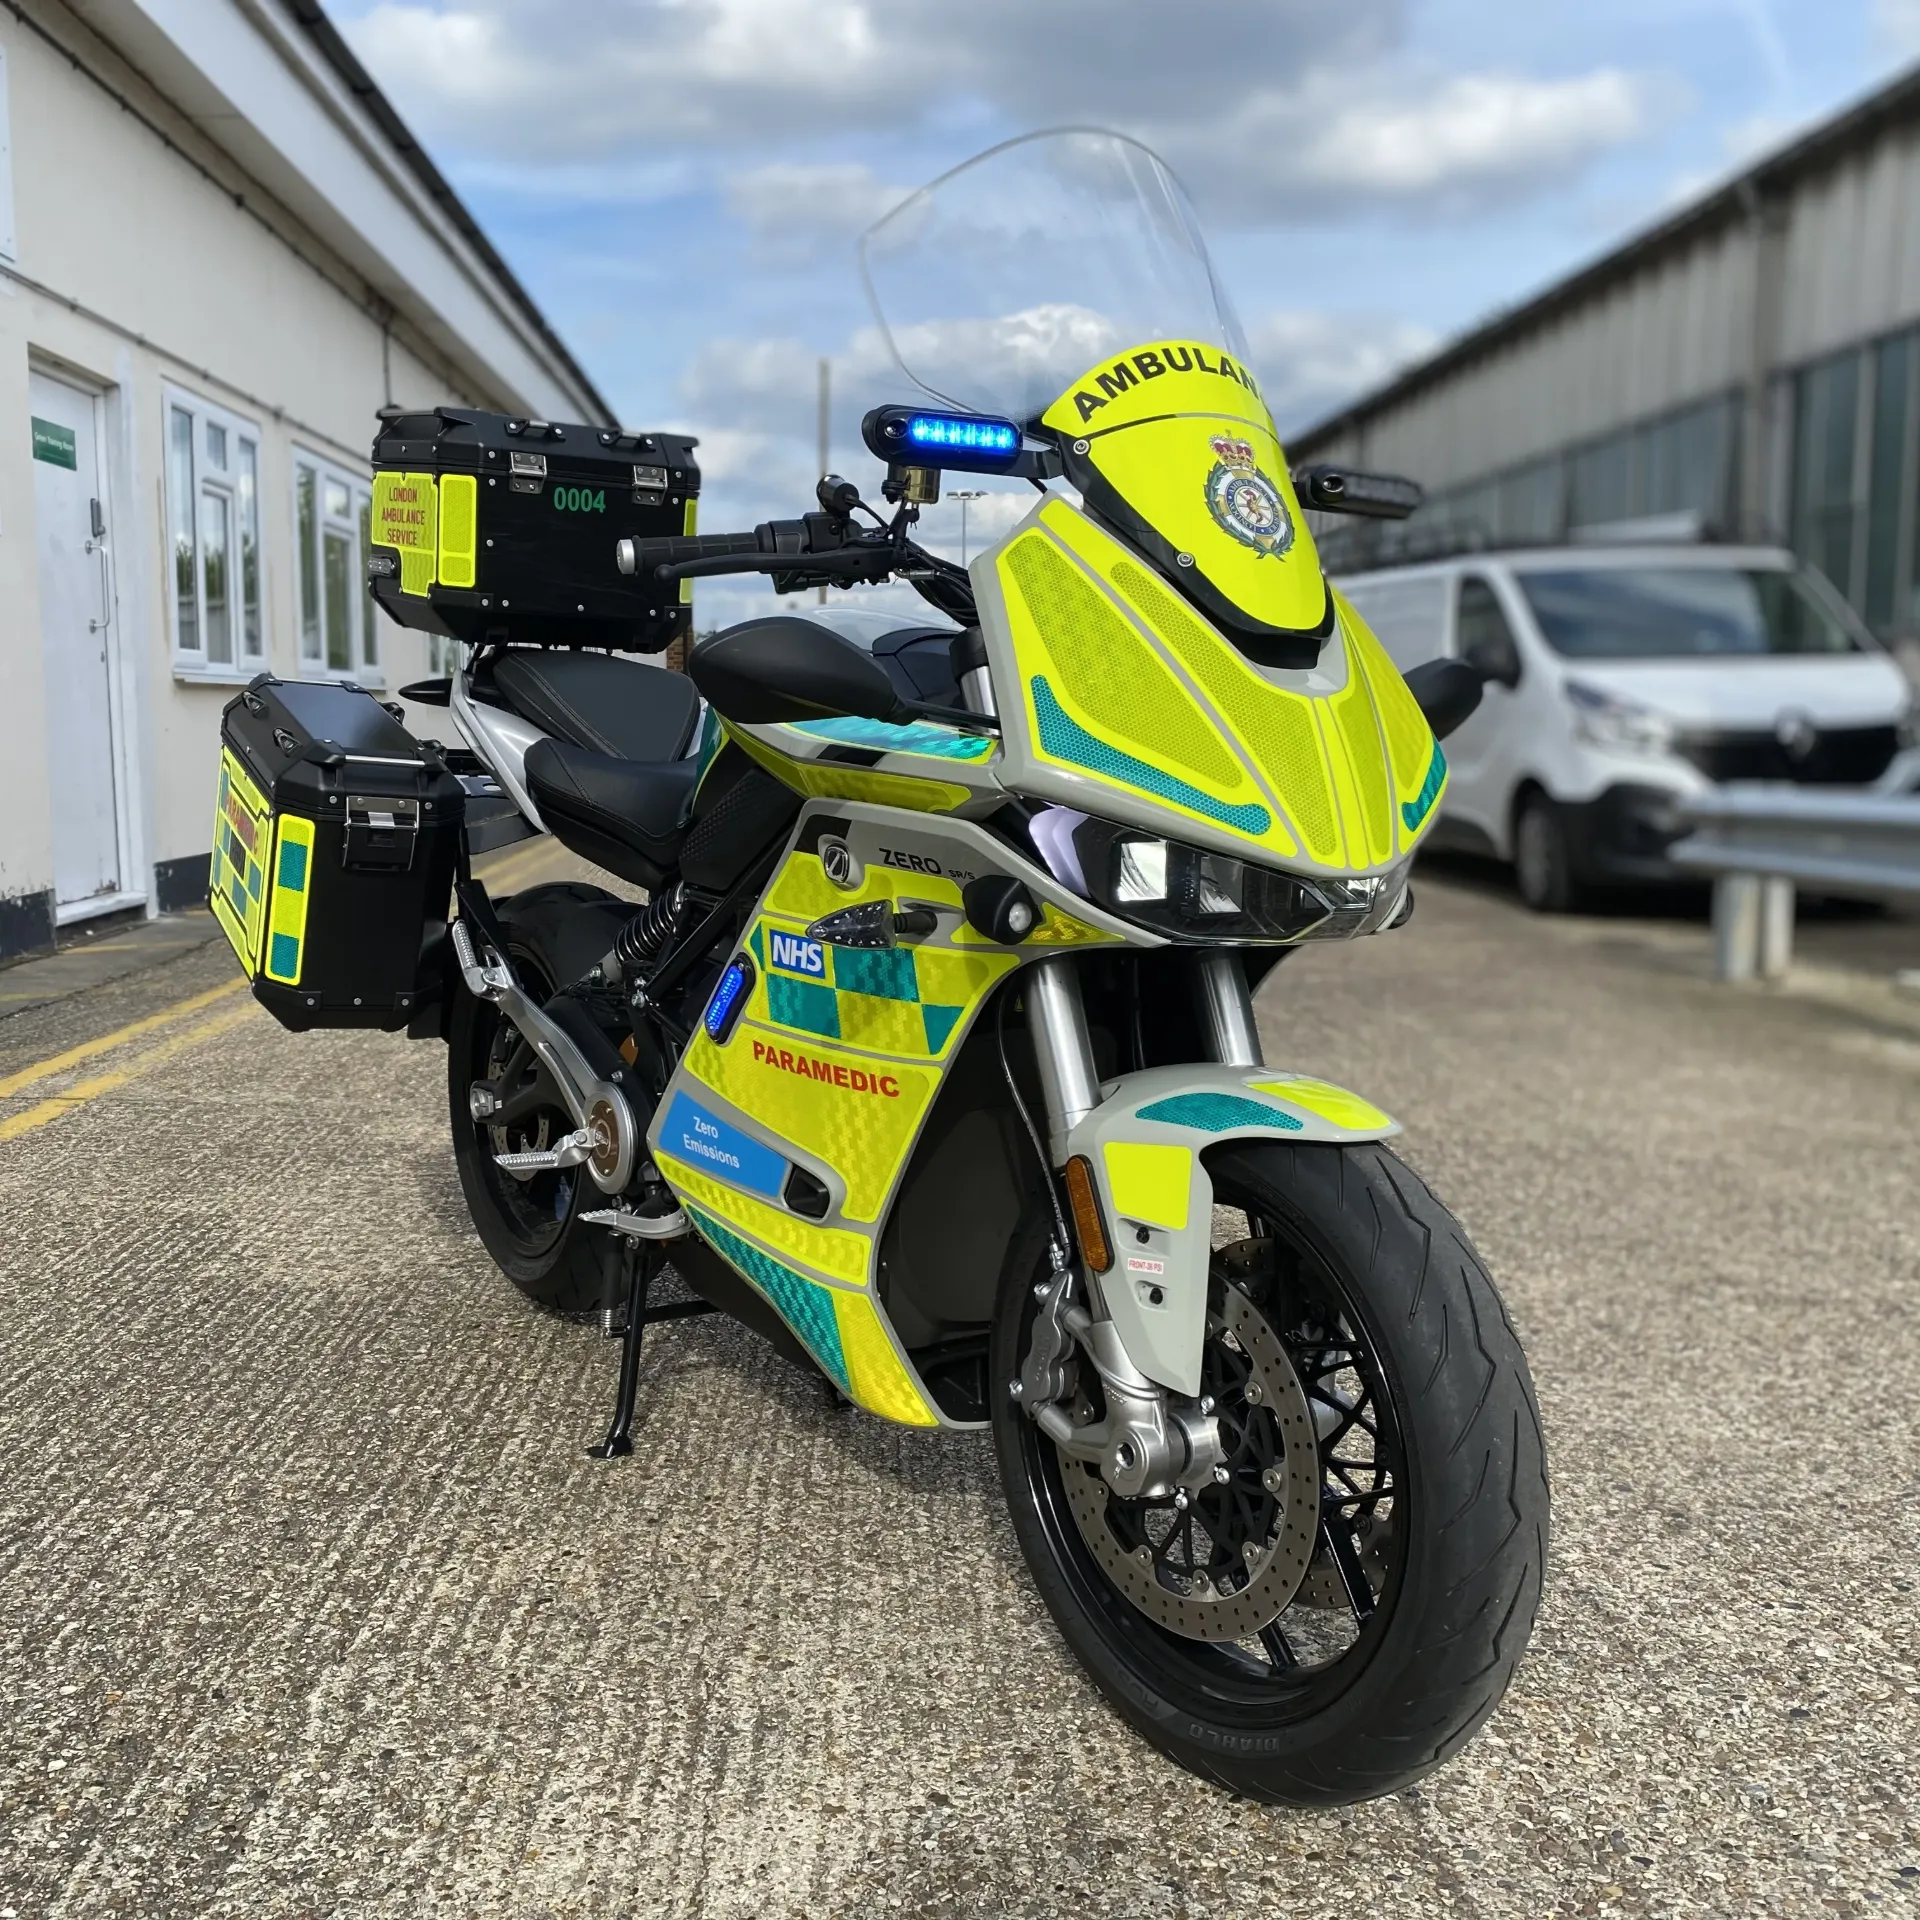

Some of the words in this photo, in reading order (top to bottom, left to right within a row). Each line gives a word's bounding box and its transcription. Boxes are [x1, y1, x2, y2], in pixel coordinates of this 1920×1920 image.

[1072, 346, 1266, 424] AMBULAN
[389, 487, 418, 502] LONDON
[554, 487, 606, 513] 0004
[381, 508, 425, 526] AMBULANCE
[387, 528, 418, 546] SERVICE
[879, 848, 942, 875] ZERO
[948, 869, 976, 880] SR/S
[772, 935, 823, 973] NHS
[752, 1040, 900, 1098] PARAMEDIC
[693, 1116, 719, 1139] Zero
[683, 1133, 740, 1169] Emissions
[1188, 1722, 1280, 1752] DIABLO
